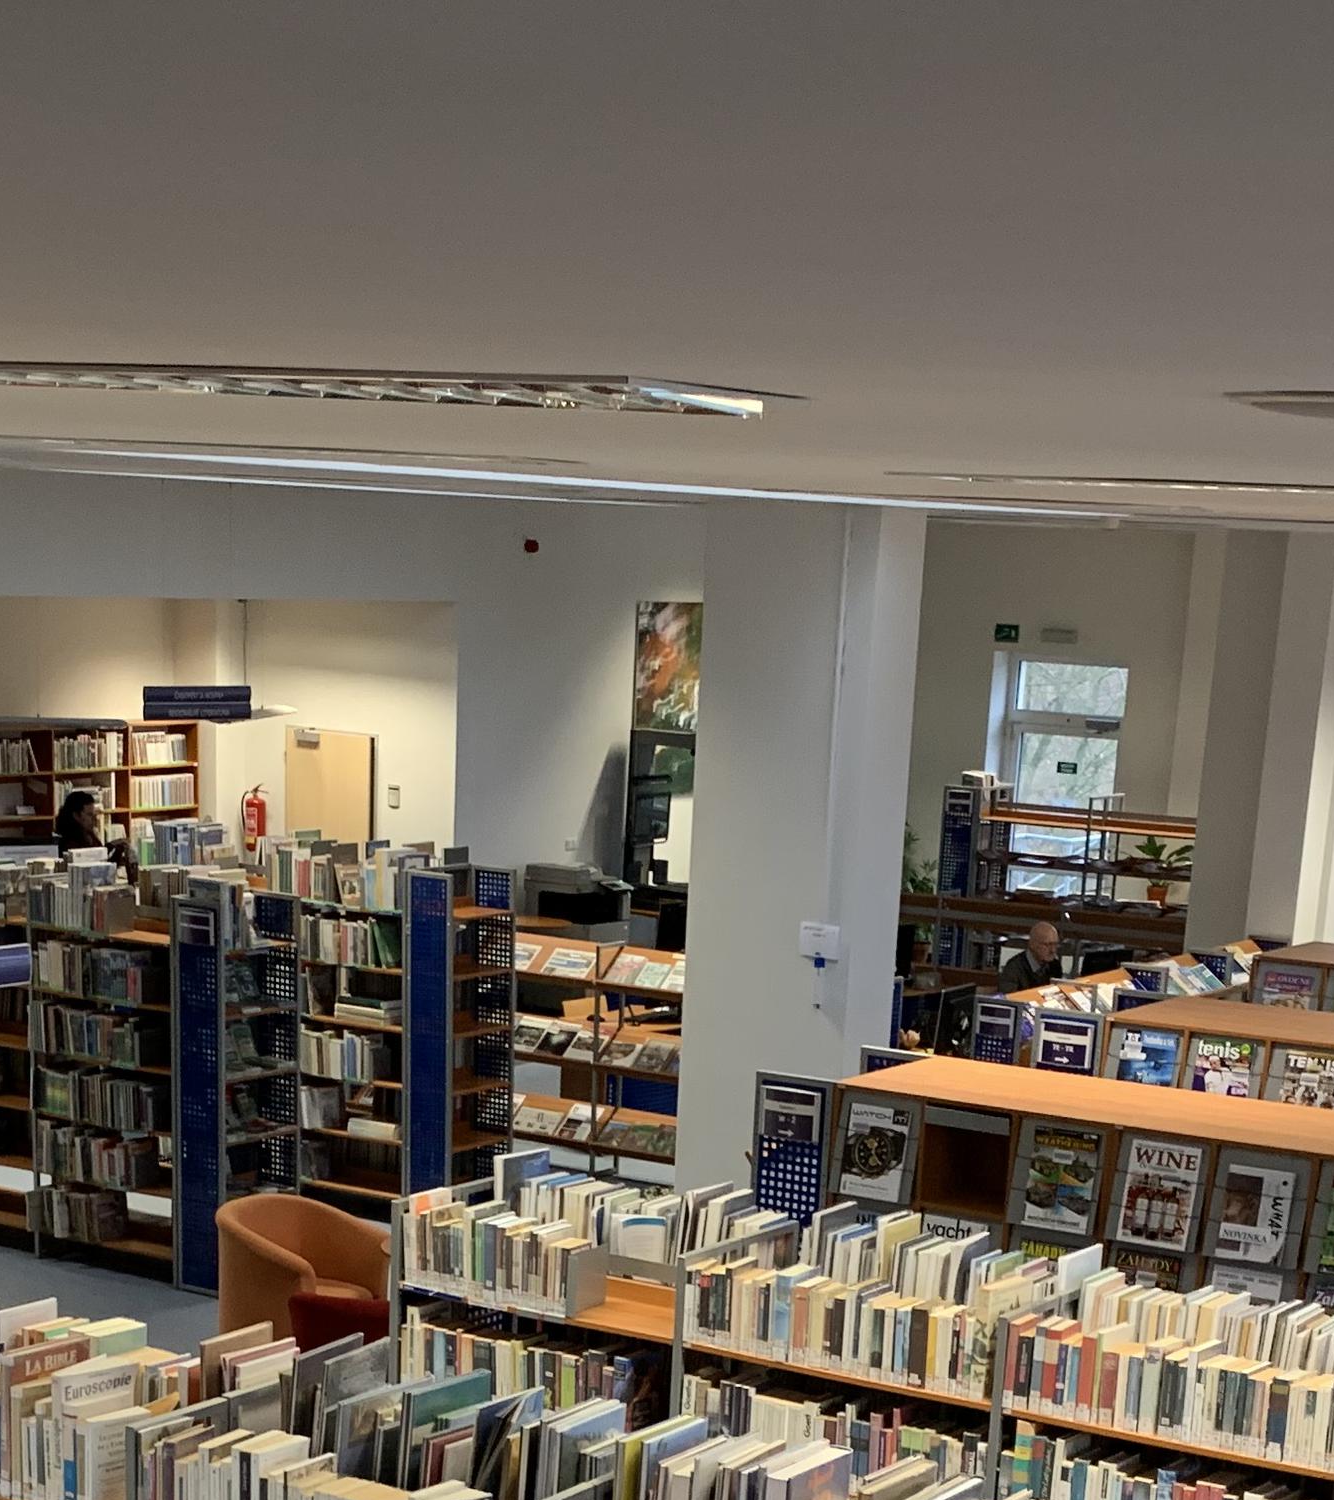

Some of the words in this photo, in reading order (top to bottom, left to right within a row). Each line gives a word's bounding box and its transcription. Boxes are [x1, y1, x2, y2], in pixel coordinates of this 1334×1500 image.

[1198, 1039, 1240, 1061] tenis
[852, 1107, 892, 1120] WATCH
[1135, 1145, 1198, 1172] WINE
[926, 1219, 972, 1242] yacht
[1222, 1227, 1268, 1245] NOVINKA
[24, 1358, 43, 1377] LA
[44, 1350, 78, 1372] BIBLE
[64, 1373, 132, 1402] Euroscopie
